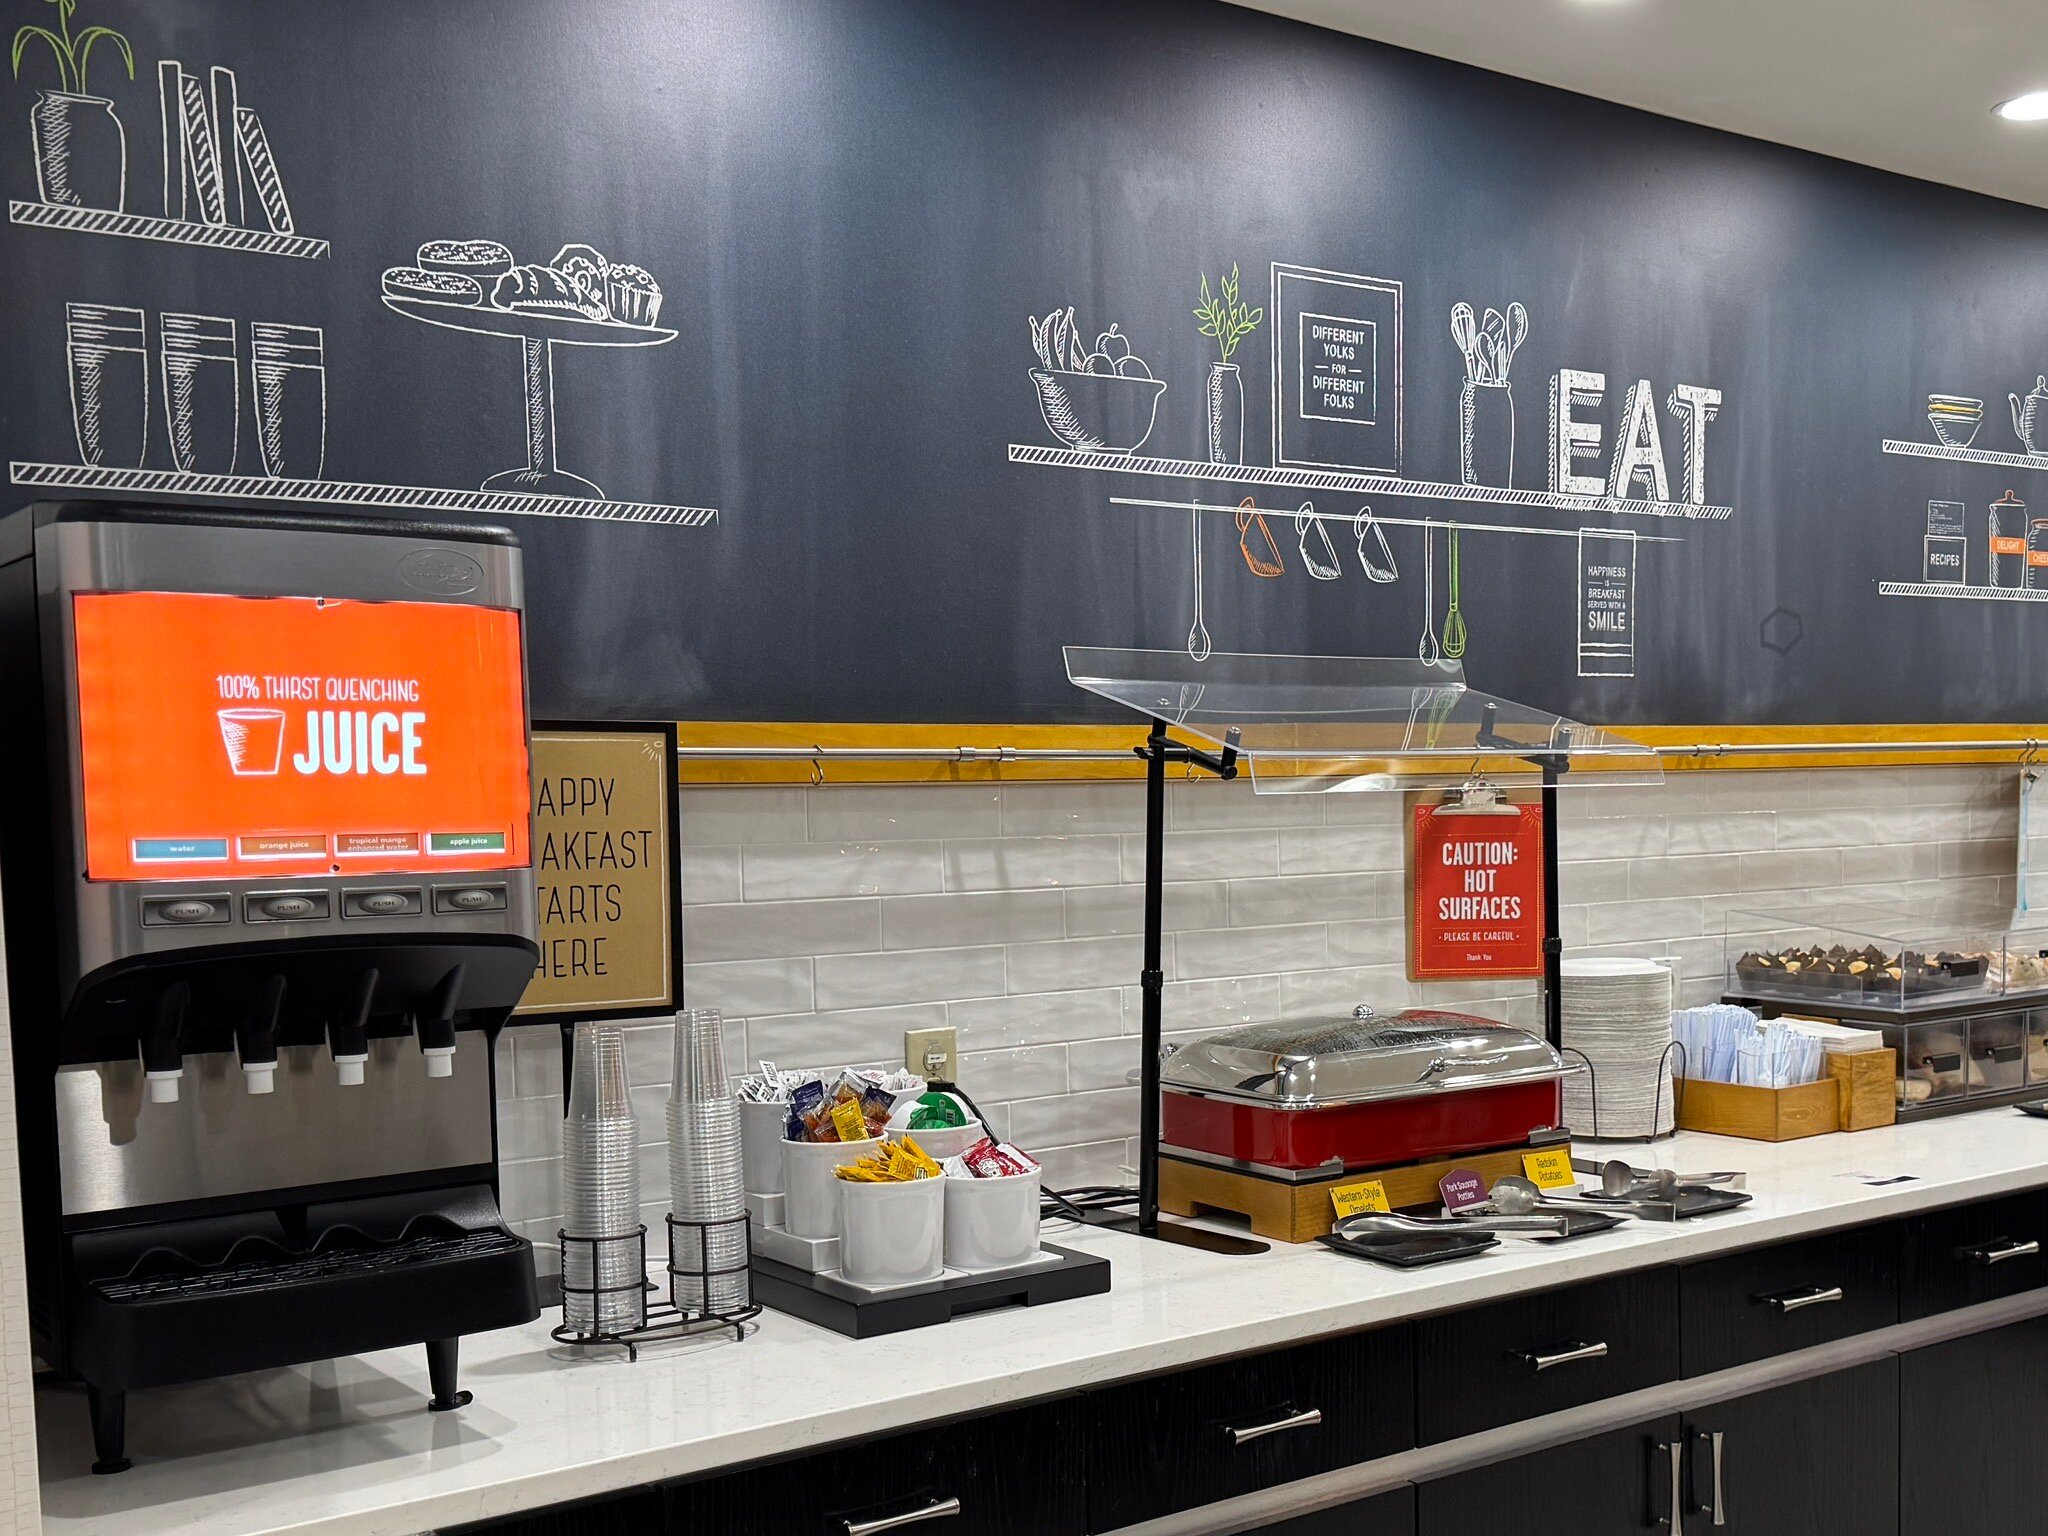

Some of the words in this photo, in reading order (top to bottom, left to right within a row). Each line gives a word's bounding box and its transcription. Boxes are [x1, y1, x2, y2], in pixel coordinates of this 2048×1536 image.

[1312, 324, 1365, 345] DIFFERENT
[1323, 343, 1355, 360] YOLKS
[1331, 364, 1346, 375] FOR
[1312, 375, 1365, 394] DIFFERENT
[1323, 393, 1355, 410] FOLKS
[1552, 368, 1721, 508] EAT
[1930, 553, 1960, 567] RECIPES
[1587, 565, 1627, 578] HAPPINESS
[1588, 588, 1626, 599] BREAKFAST
[1587, 600, 1607, 609] SERVED
[1608, 601, 1621, 609] WITH
[1588, 611, 1626, 631] SMILE
[216, 675, 260, 699] 100%
[263, 676, 320, 700] THIRST
[325, 678, 420, 702] QUENCHING
[293, 710, 427, 775] JUICE
[537, 777, 615, 817] APPY
[259, 842, 288, 850] orange
[289, 841, 309, 850] juice
[349, 837, 379, 846] tropical
[380, 837, 407, 845] mango
[541, 830, 653, 871] AKFAST
[1442, 842, 1518, 866] CAUTION:
[1464, 869, 1496, 893] HOT
[537, 884, 622, 925] TARTS
[1438, 896, 1521, 920] SURFACES
[1443, 932, 1470, 941] PLEASE
[1472, 932, 1481, 941] BE
[1483, 931, 1514, 941] CAREFUL
[1536, 1157, 1558, 1168] Redskin
[1538, 1171, 1563, 1181] Potatoes
[1446, 1182, 1458, 1192] Pork
[1457, 1179, 1478, 1190] Sausage
[1334, 1186, 1381, 1203] Western-Style
[1457, 1191, 1475, 1201] Patties
